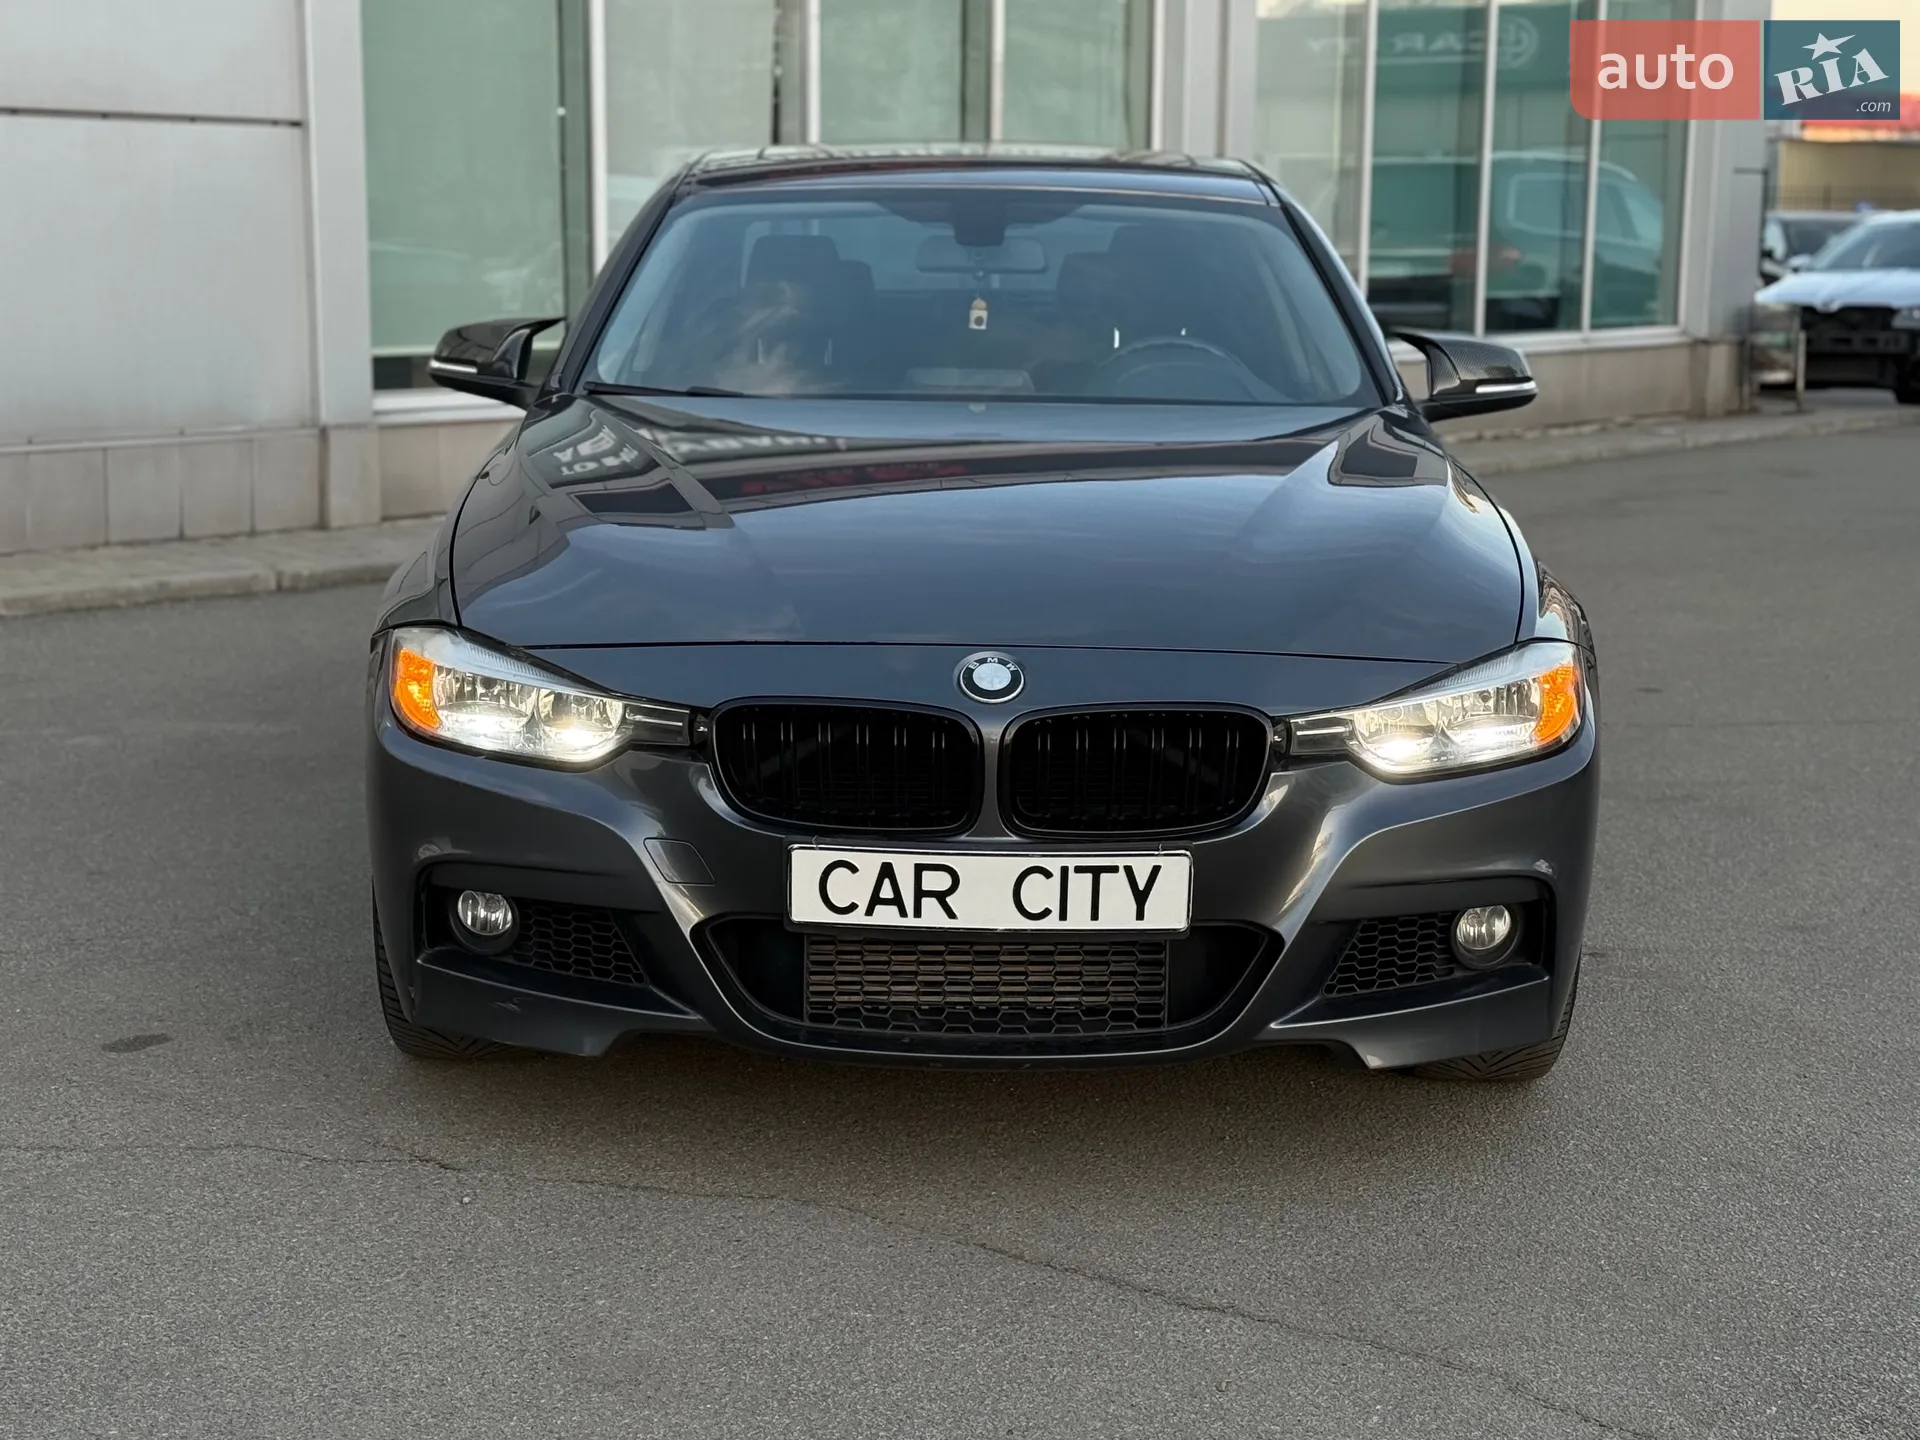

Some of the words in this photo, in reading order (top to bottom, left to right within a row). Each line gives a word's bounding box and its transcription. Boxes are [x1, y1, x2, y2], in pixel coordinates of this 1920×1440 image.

[968, 657, 1018, 671] BMW
[819, 859, 960, 920] CAR
[1012, 864, 1162, 921] CITY
